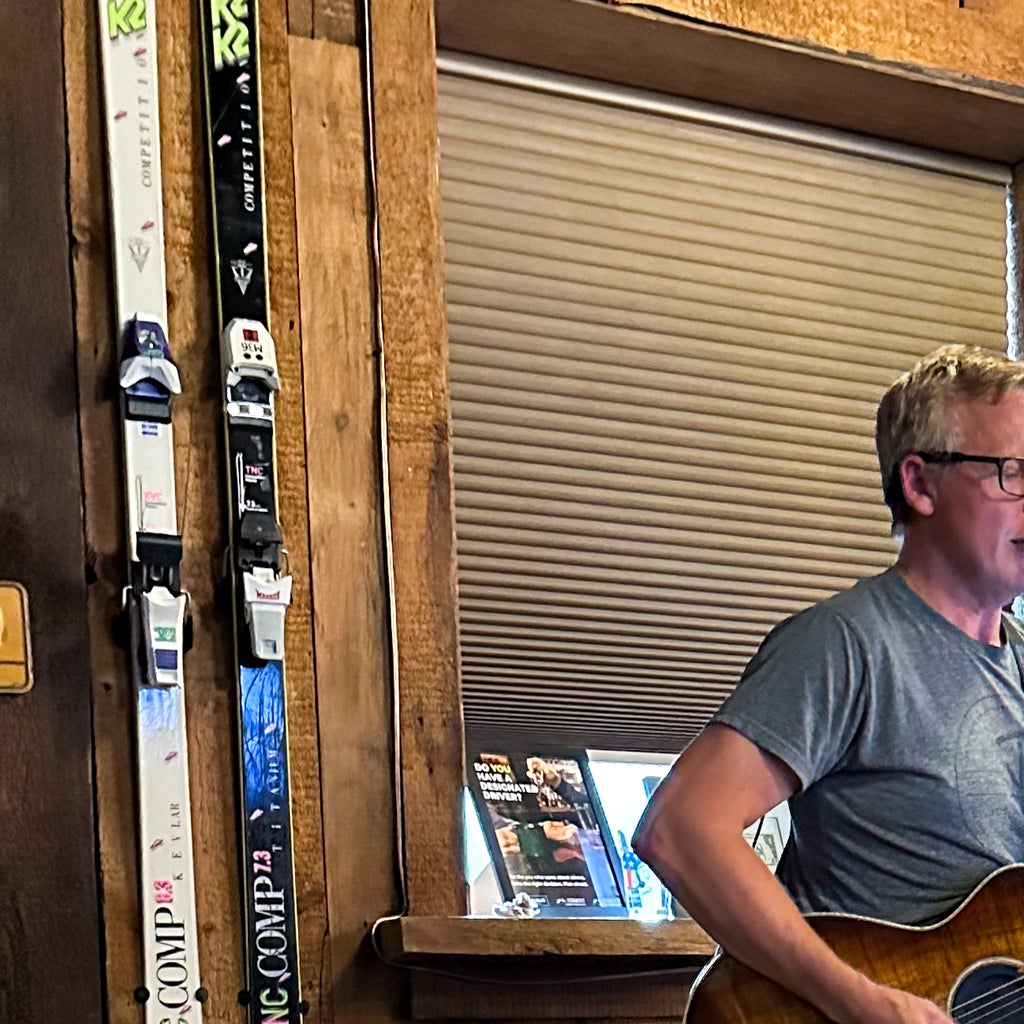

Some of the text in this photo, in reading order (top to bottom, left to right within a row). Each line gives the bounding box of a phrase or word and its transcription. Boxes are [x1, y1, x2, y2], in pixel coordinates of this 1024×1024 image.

[107, 0, 147, 40] K2
[212, 20, 250, 71] K2
[245, 465, 264, 475] TNC
[473, 762, 511, 774] DO YOU
[477, 772, 513, 783] HAVE A
[480, 781, 539, 794] DESIGNATED
[482, 791, 523, 802] DRIVER?
[253, 874, 289, 978] COMP
[154, 906, 189, 1009] COMP
